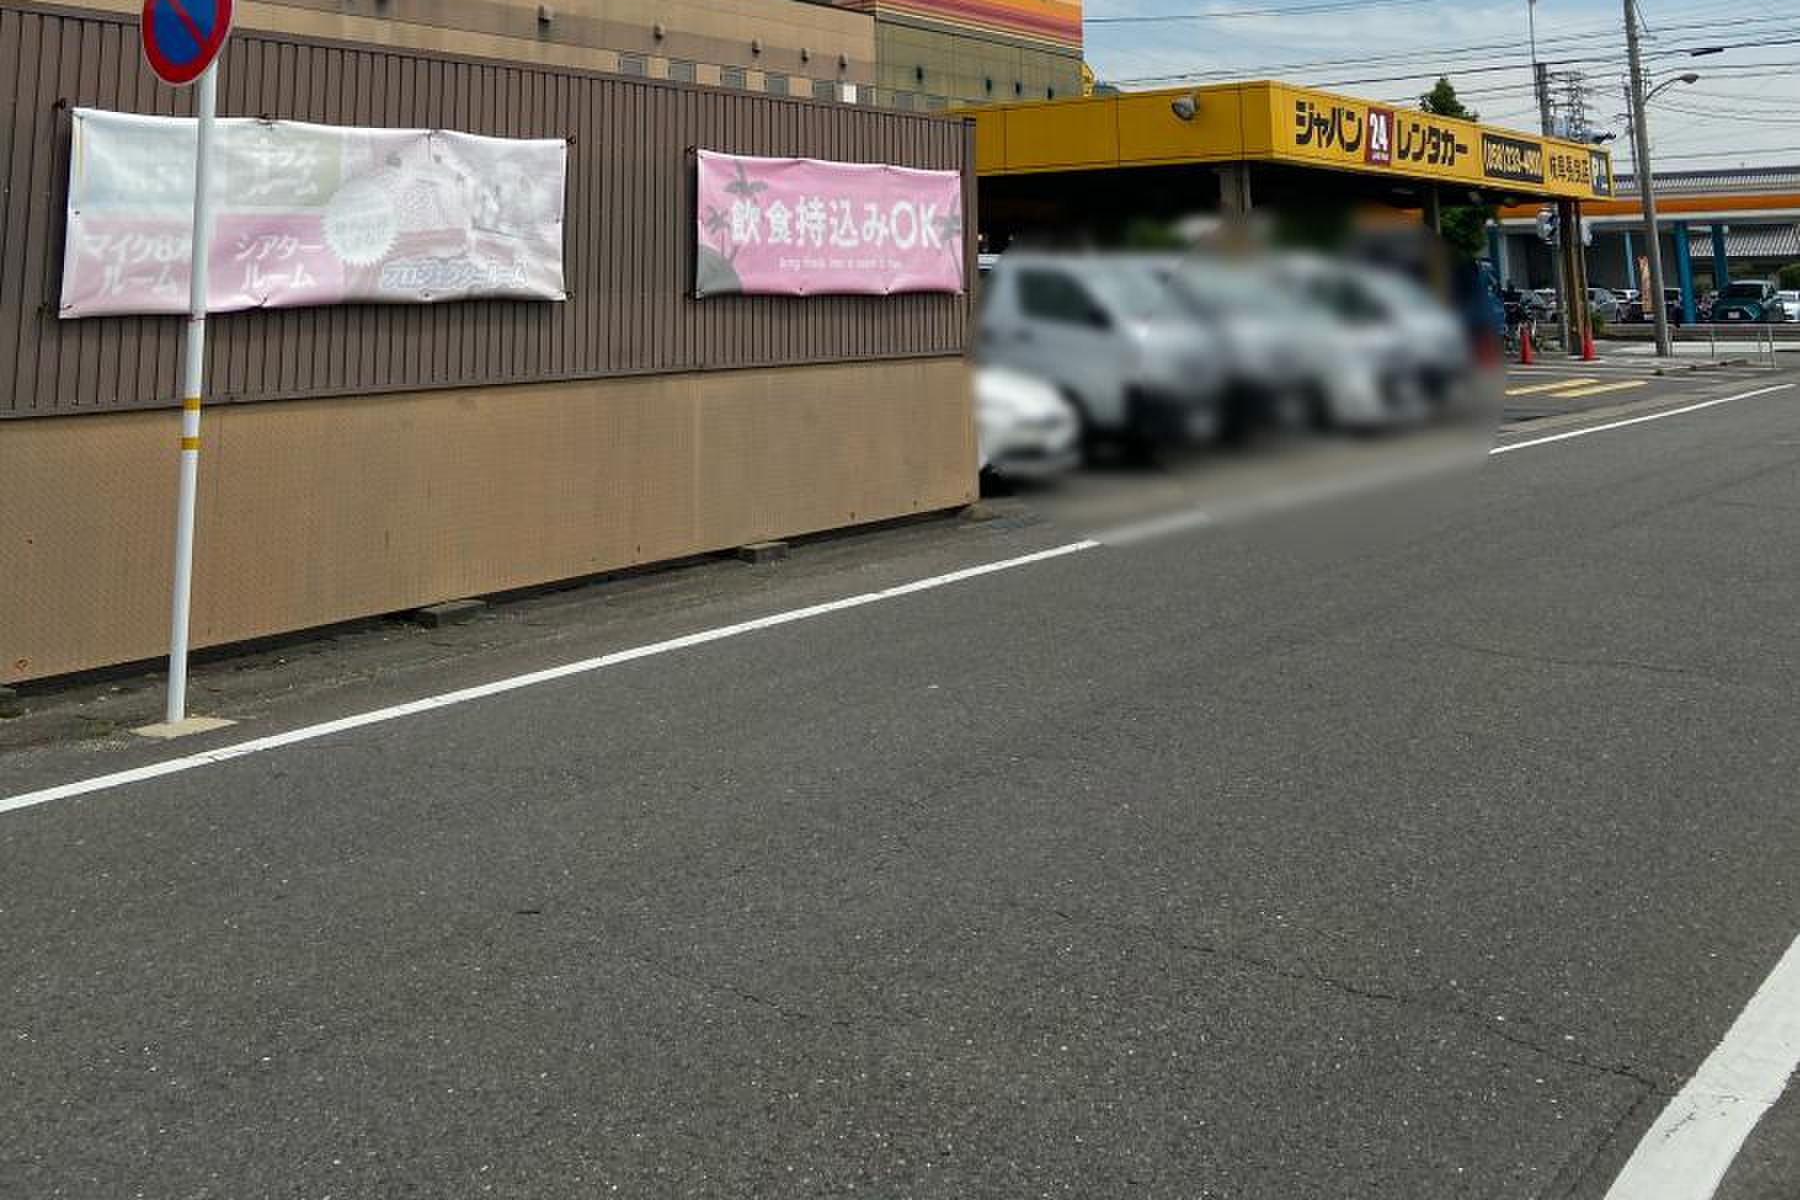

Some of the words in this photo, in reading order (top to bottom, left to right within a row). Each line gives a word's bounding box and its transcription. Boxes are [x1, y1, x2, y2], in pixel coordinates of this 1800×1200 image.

[1295, 100, 1362, 153] ジャパン
[1369, 112, 1389, 152] 24
[1397, 119, 1469, 166] レンタカー
[730, 195, 942, 250] 飲食持込みOK
[235, 232, 323, 262] シアター
[99, 263, 179, 298] ルーム
[241, 262, 318, 293] ルーム
